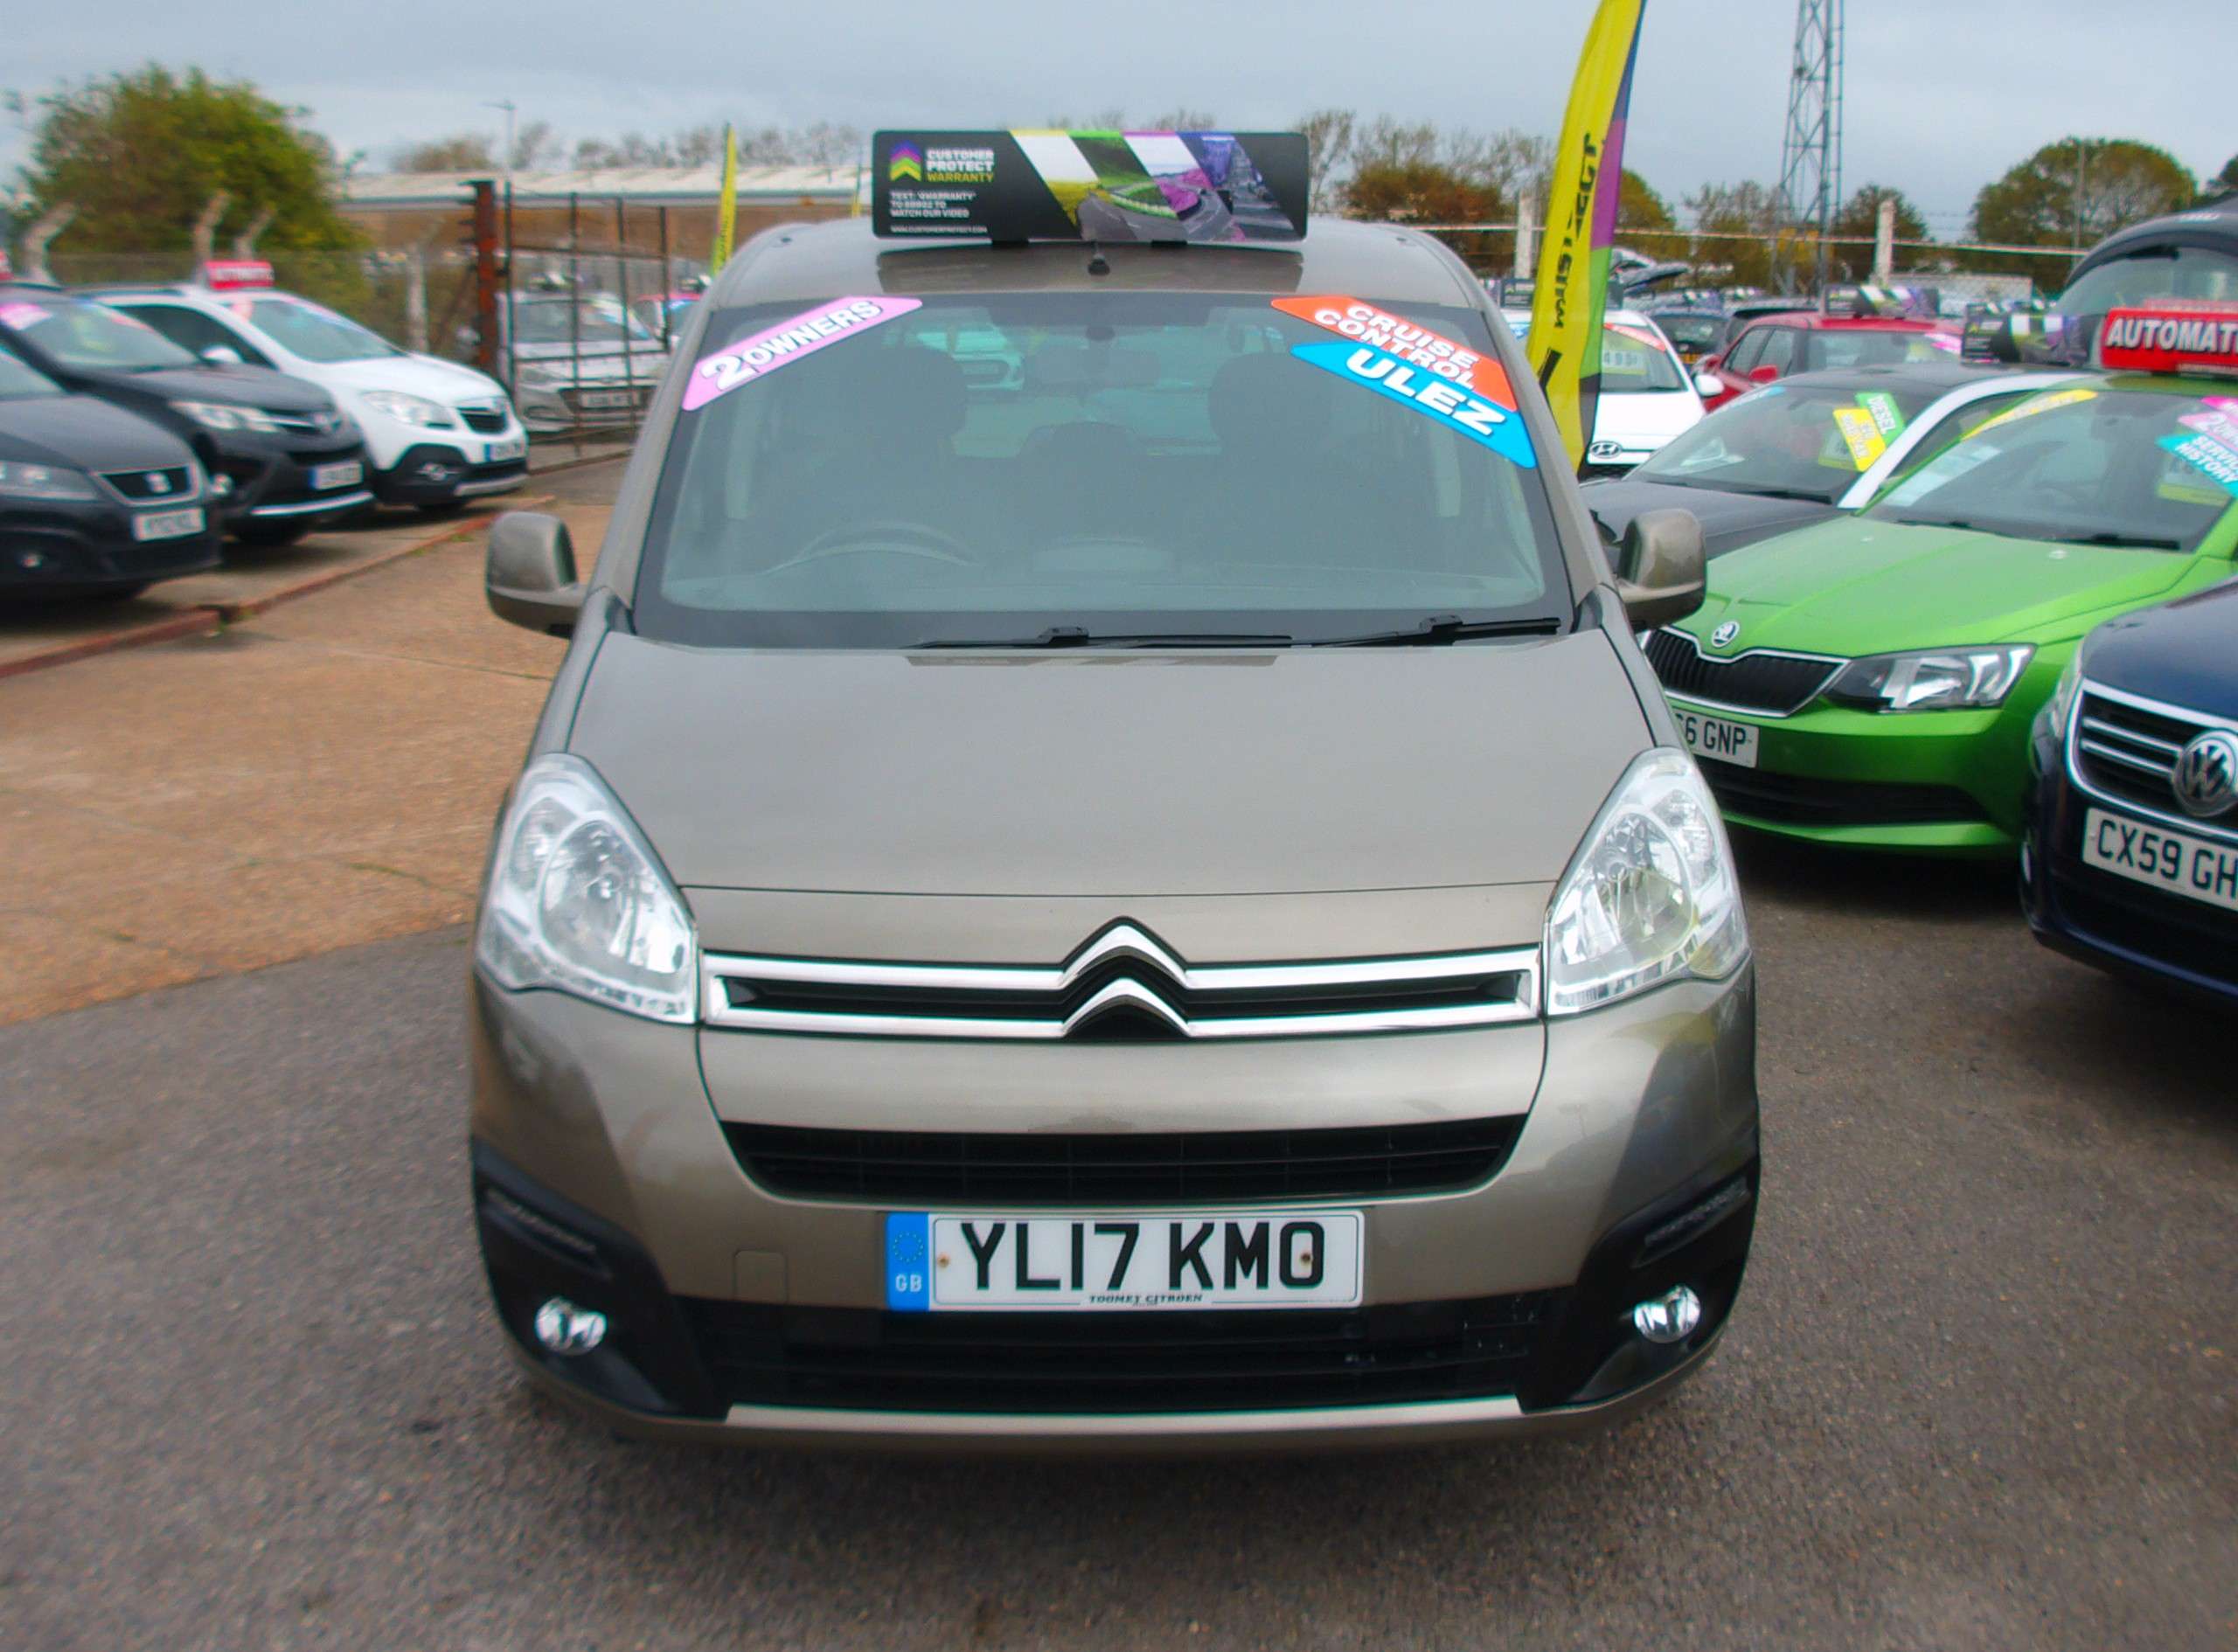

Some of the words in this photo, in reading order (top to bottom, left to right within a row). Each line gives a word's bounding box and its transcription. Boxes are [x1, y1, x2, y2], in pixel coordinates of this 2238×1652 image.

[926, 148, 994, 161] CUSTOMER
[927, 161, 995, 171] PROTECT
[927, 172, 994, 183] WARRANTY
[1314, 309, 1475, 390] CONTROL
[1346, 305, 1480, 370] CRUISE
[2106, 318, 2238, 353] AUTOMAT
[1346, 347, 1506, 437] ULEZ
[1705, 720, 1746, 755] GNP
[2099, 819, 2182, 882] CX59
[961, 1223, 1139, 1291] YL17
[1169, 1221, 1324, 1290] KMO
[895, 1274, 922, 1292] GB
